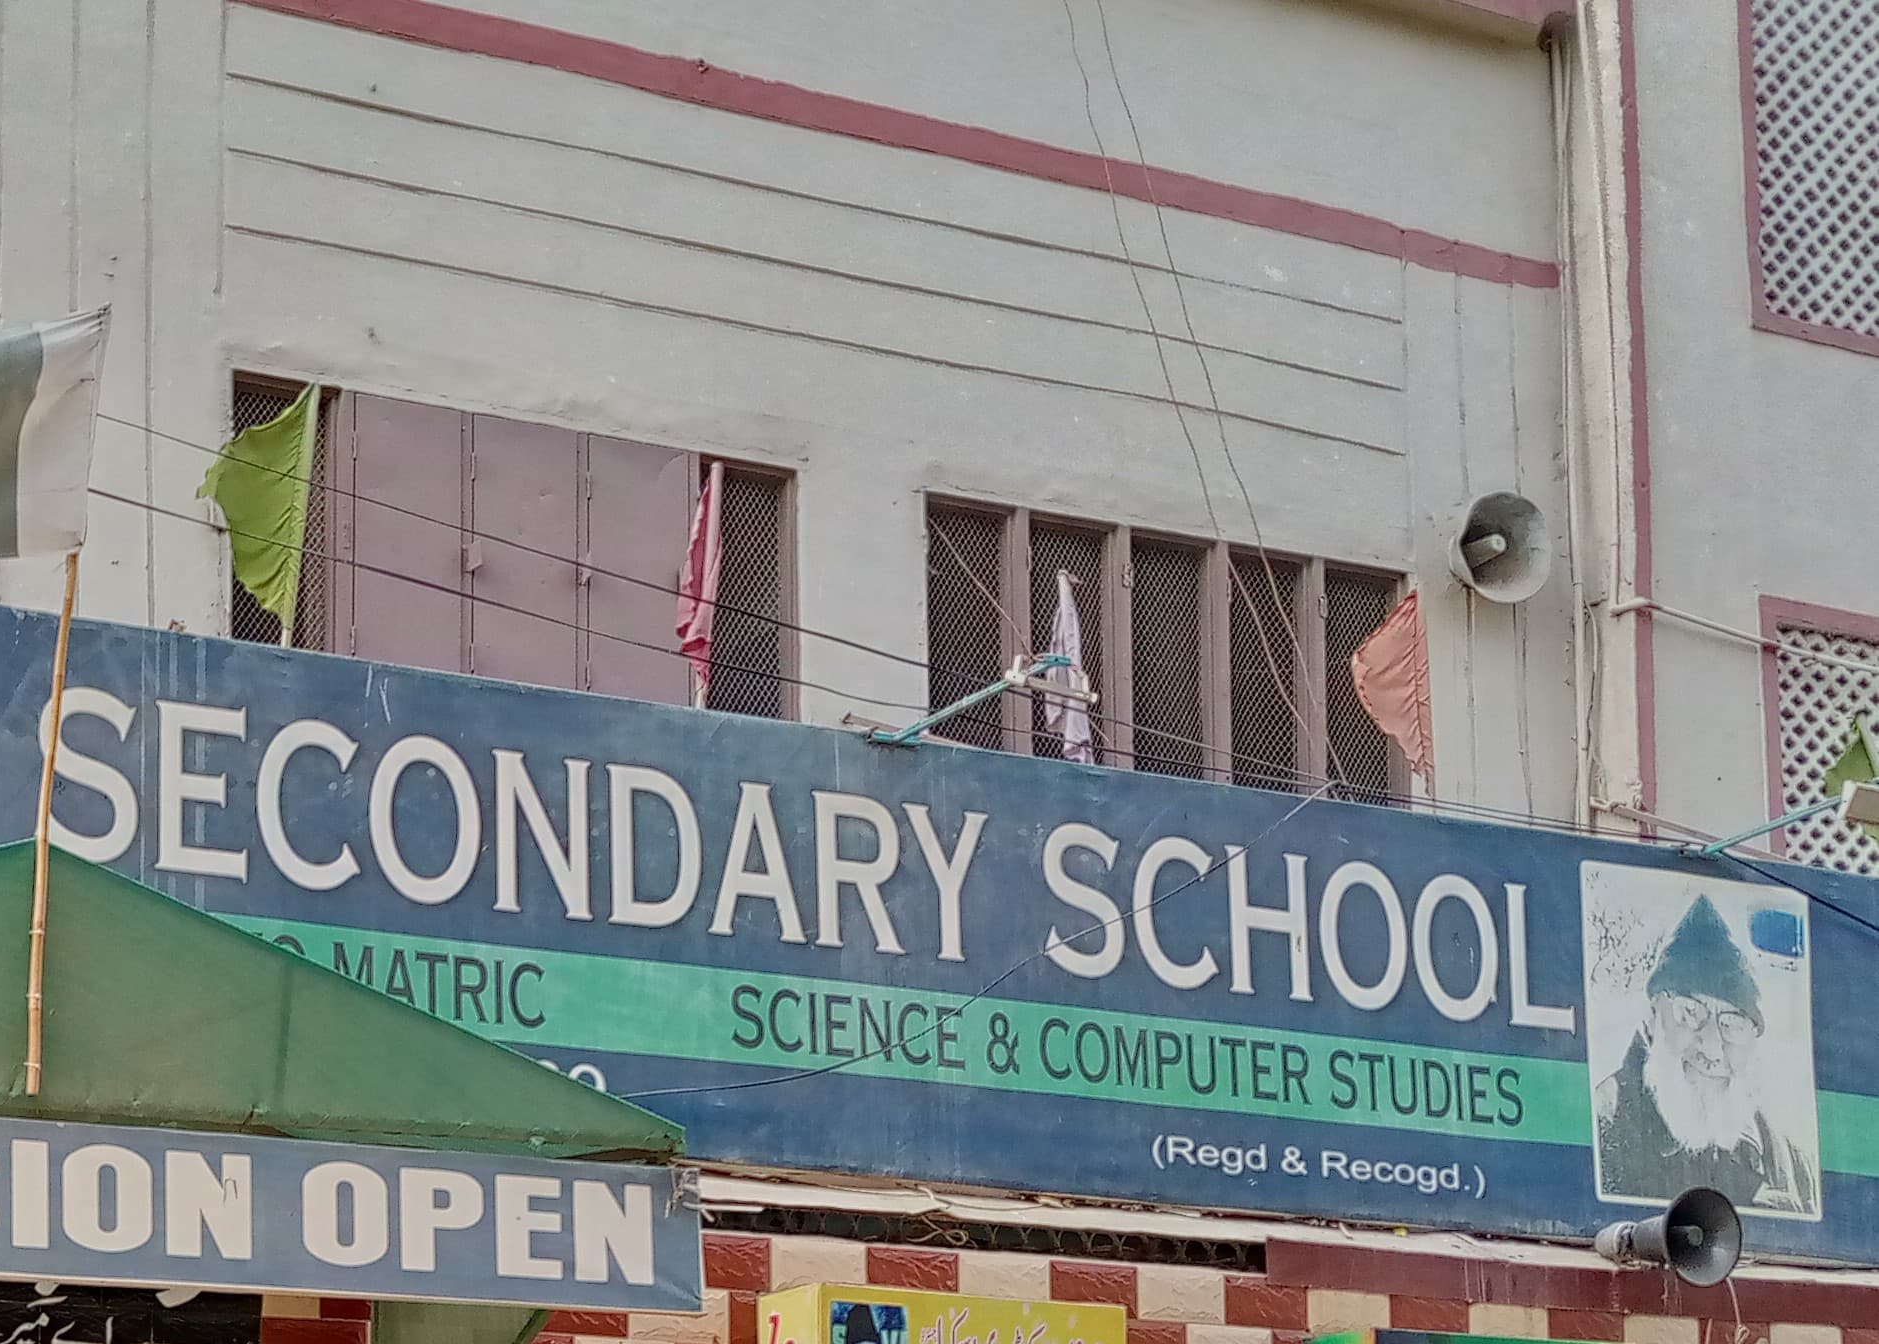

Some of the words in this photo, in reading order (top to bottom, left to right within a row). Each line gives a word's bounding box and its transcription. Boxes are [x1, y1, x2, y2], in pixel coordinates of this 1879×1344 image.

[38, 686, 987, 962] SECONDARY
[1041, 822, 1577, 1036] SCHOOL
[730, 982, 965, 1071] SCIENCE
[987, 1012, 1021, 1074] &
[1038, 1016, 1313, 1108] COMPUTER
[1330, 1050, 1525, 1127] STUDIES
[301, 1160, 655, 1286] OPEN
[1151, 1136, 1267, 1177] (Regd
[1282, 1147, 1309, 1178] &
[1319, 1150, 1487, 1200] Recogd.)
